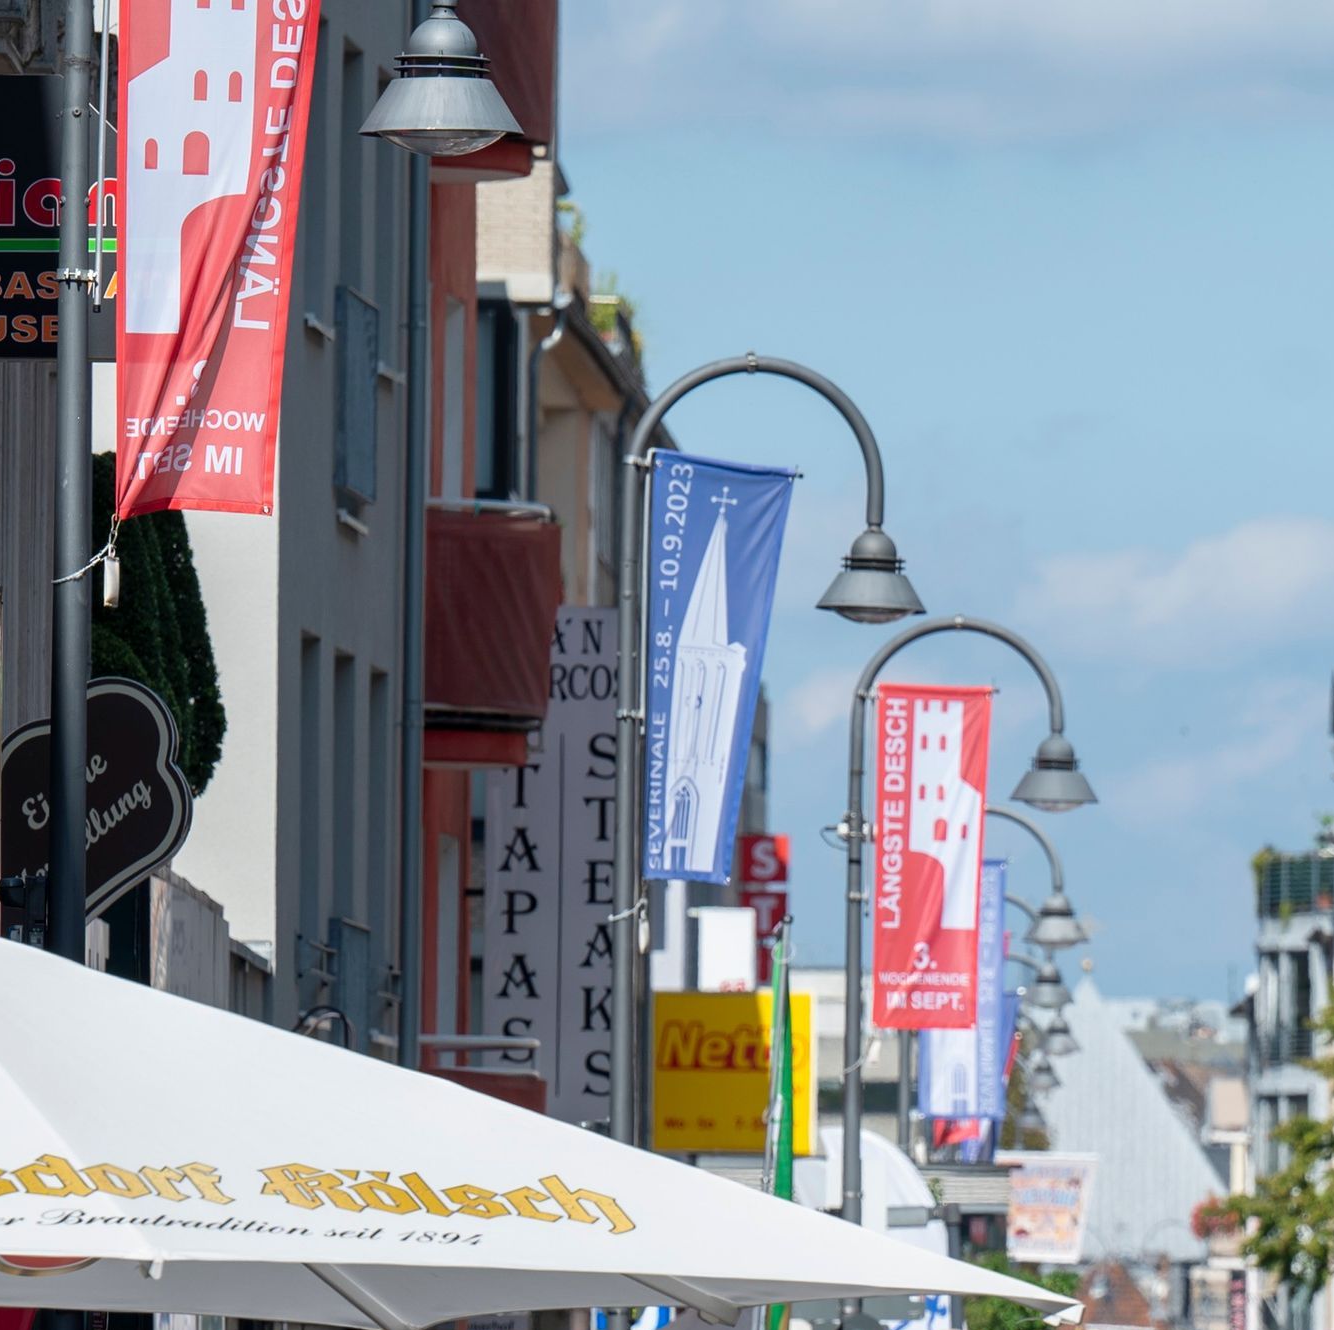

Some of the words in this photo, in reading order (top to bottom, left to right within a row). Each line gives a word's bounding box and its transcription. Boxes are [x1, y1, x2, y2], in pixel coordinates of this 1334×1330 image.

[659, 463, 694, 592] 10.9.2023
[653, 624, 673, 689] 25.8.
[649, 711, 667, 870] SEVERINALE
[885, 697, 909, 793] DESCH
[879, 799, 904, 930] LÄNGSTE
[496, 763, 541, 1064] TAPAS
[578, 732, 617, 1097] STEAKS
[912, 940, 938, 971] 3.
[910, 991, 966, 1011] SEPT.
[35, 1207, 311, 1237] Brautradition
[323, 1226, 382, 1242] seit
[398, 1228, 484, 1246] 1894
[258, 1163, 636, 1234] Kölsch
